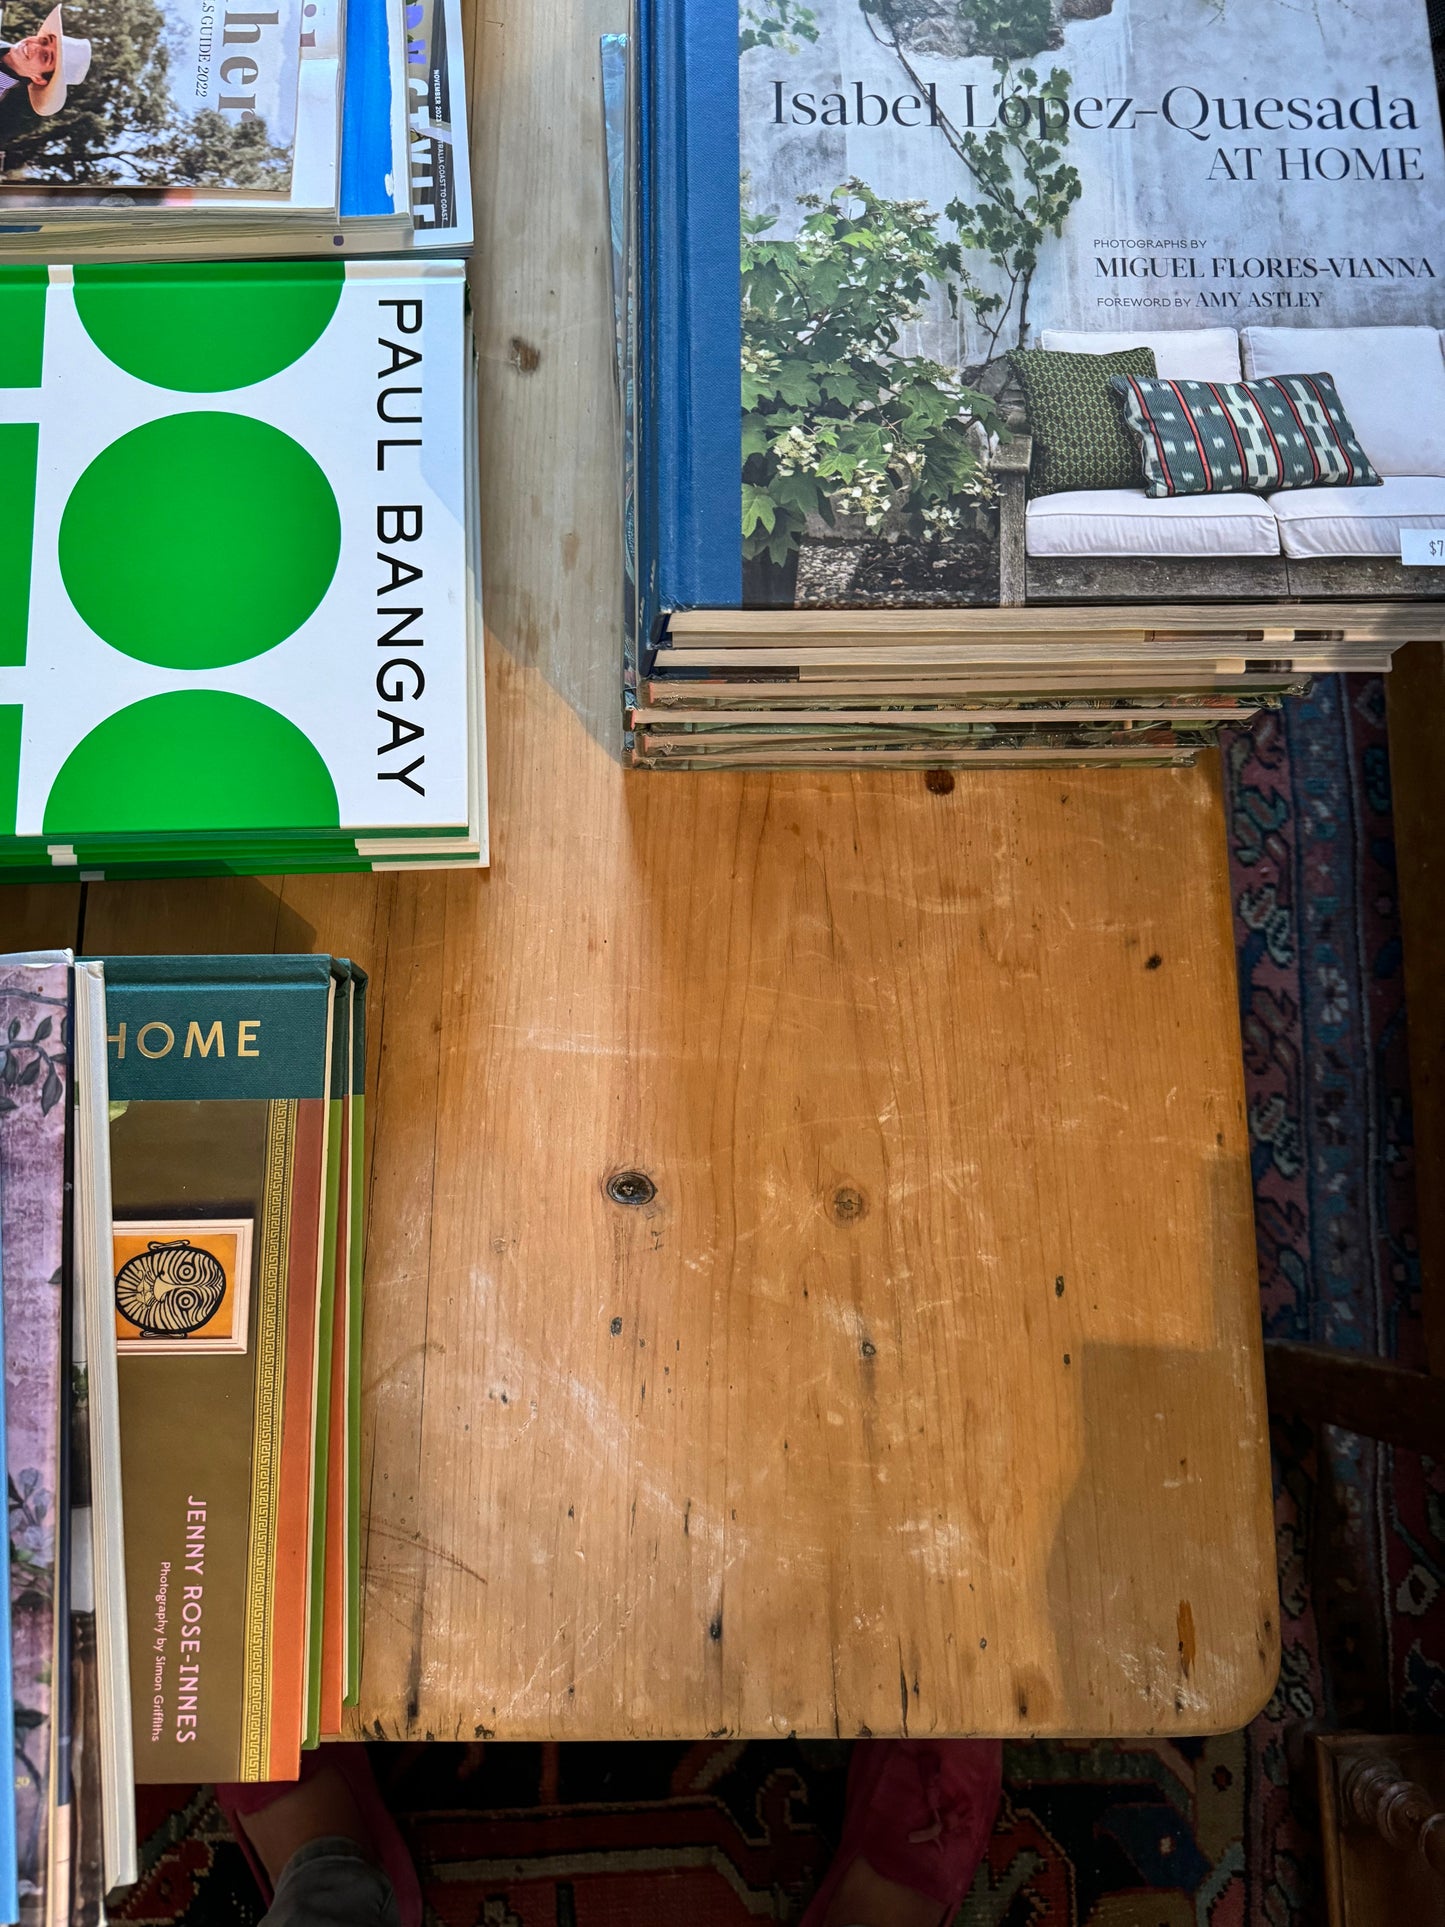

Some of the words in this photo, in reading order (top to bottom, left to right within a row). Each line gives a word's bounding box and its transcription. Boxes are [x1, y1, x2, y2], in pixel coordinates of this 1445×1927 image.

[198, 15, 214, 63] GUIDE
[218, 0, 279, 122] her
[195, 65, 210, 98] 2022
[433, 69, 442, 105] NOVEMBER
[768, 80, 943, 127] Isabel
[961, 82, 1422, 141] López-Quesada
[436, 128, 446, 164] TRALIA
[1205, 147, 1262, 181] AT
[1276, 147, 1424, 181] HOME
[438, 164, 446, 188] COAST
[440, 187, 447, 198] TO
[440, 199, 449, 222] COAST
[1093, 238, 1188, 249] PHOTOGRAPHS
[1190, 239, 1207, 249] BY
[1094, 256, 1205, 278] MIGUEL
[1211, 256, 1437, 279] FLORES-VIANNA
[1097, 297, 1171, 308] FOREWORD
[1175, 297, 1192, 308] BY
[1196, 291, 1241, 308] AMY
[1247, 291, 1324, 308] ASTLEY
[376, 298, 423, 472] PAUL
[376, 504, 426, 798] BANGAY
[184, 1494, 207, 1576] JENNY
[154, 1561, 171, 1635] Photography
[152, 1637, 168, 1652] by
[154, 1655, 166, 1691] Simon
[175, 1585, 204, 1743] ROSE-INNES
[151, 1694, 165, 1742] Griffiths
